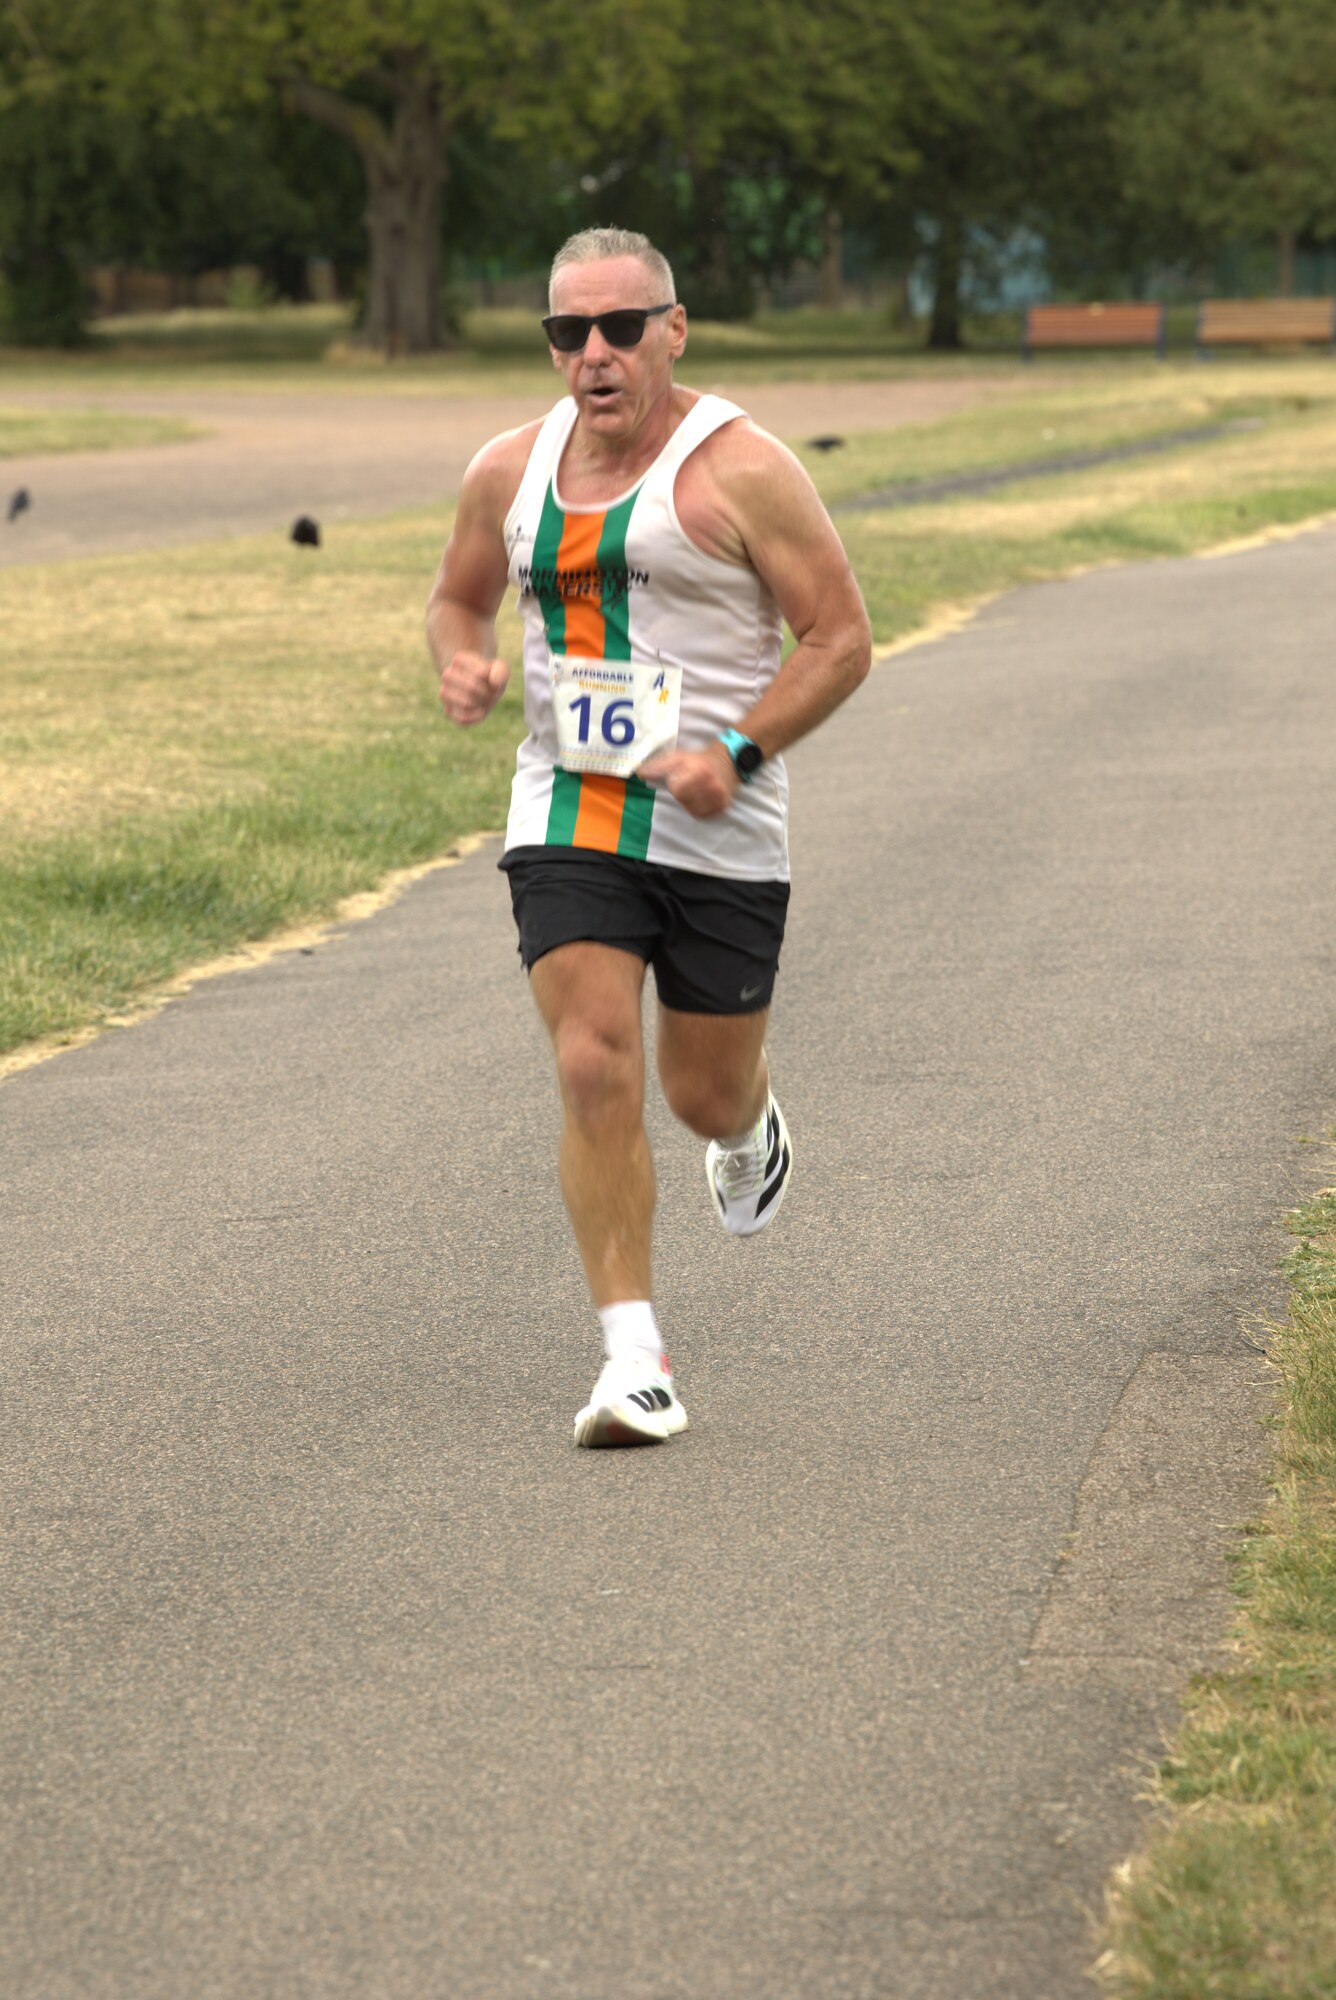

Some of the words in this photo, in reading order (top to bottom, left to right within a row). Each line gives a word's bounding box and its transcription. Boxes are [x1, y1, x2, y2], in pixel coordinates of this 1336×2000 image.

[572, 667, 634, 683] AFFORDABLE
[579, 679, 626, 694] RUNNING
[568, 694, 636, 747] 16
